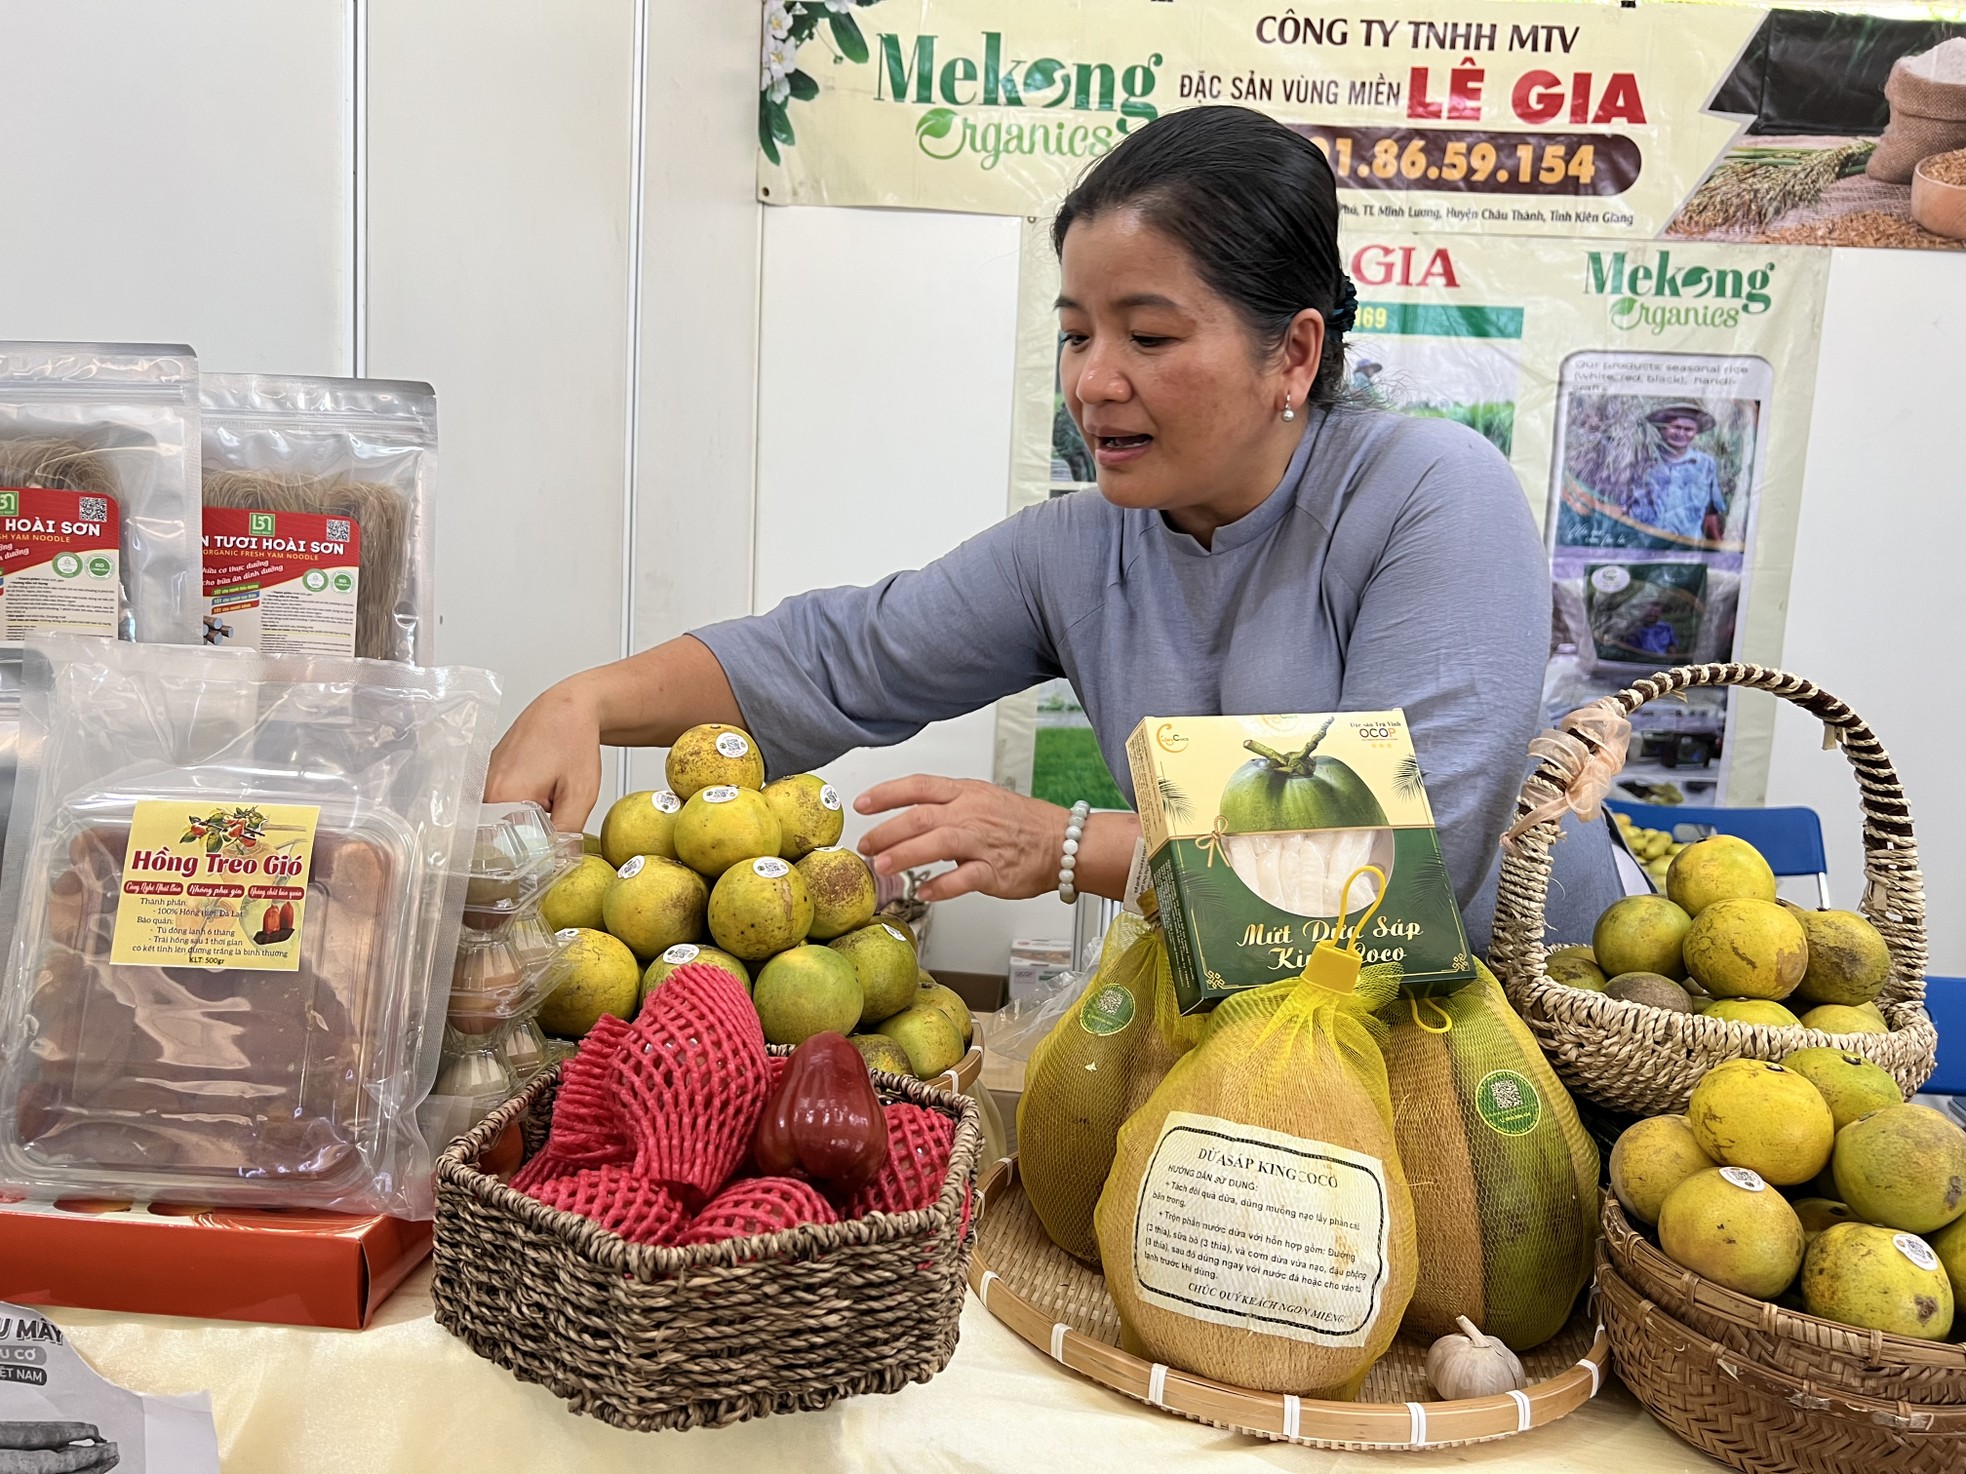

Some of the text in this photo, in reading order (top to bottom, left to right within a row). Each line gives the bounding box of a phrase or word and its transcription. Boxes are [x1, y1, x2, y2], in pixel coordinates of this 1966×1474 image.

[1256, 10, 1580, 53] CÔNG TY TNHH MTV
[874, 31, 1163, 135] Mekong
[1180, 56, 1648, 125] ĐẶC SẢN VÙNG MIỀN LÊ GIA
[915, 108, 1113, 171] Organics
[1378, 205, 1404, 217] Minh
[1575, 211, 1599, 223] Kiên
[1352, 244, 1460, 288] GIA
[1583, 250, 1775, 314] Mekong
[1609, 296, 1740, 335] Organics
[6, 516, 101, 537] HOÀI SƠN
[10, 533, 71, 543] YAM NOODLE
[214, 535, 258, 549] TƯƠI
[262, 537, 306, 552] HOÀI
[310, 541, 344, 555] SƠN
[240, 550, 265, 558] FRESH
[1359, 727, 1396, 738] OCOP
[131, 846, 303, 877] Hồng Treo Gió
[157, 908, 178, 916] 100%
[1236, 923, 1294, 947] Mứt
[1372, 915, 1424, 941] Sáp
[205, 957, 225, 966] 500gr
[1167, 1164, 1195, 1178] HƯỚNG
[1200, 1238, 1209, 1248] (3
[1221, 1258, 1244, 1272] ngay
[1188, 1282, 1219, 1297] CHÚC
[1278, 1302, 1311, 1317] NGON
[14, 1348, 36, 1361] CƠ
[16, 1369, 42, 1383] NAM
